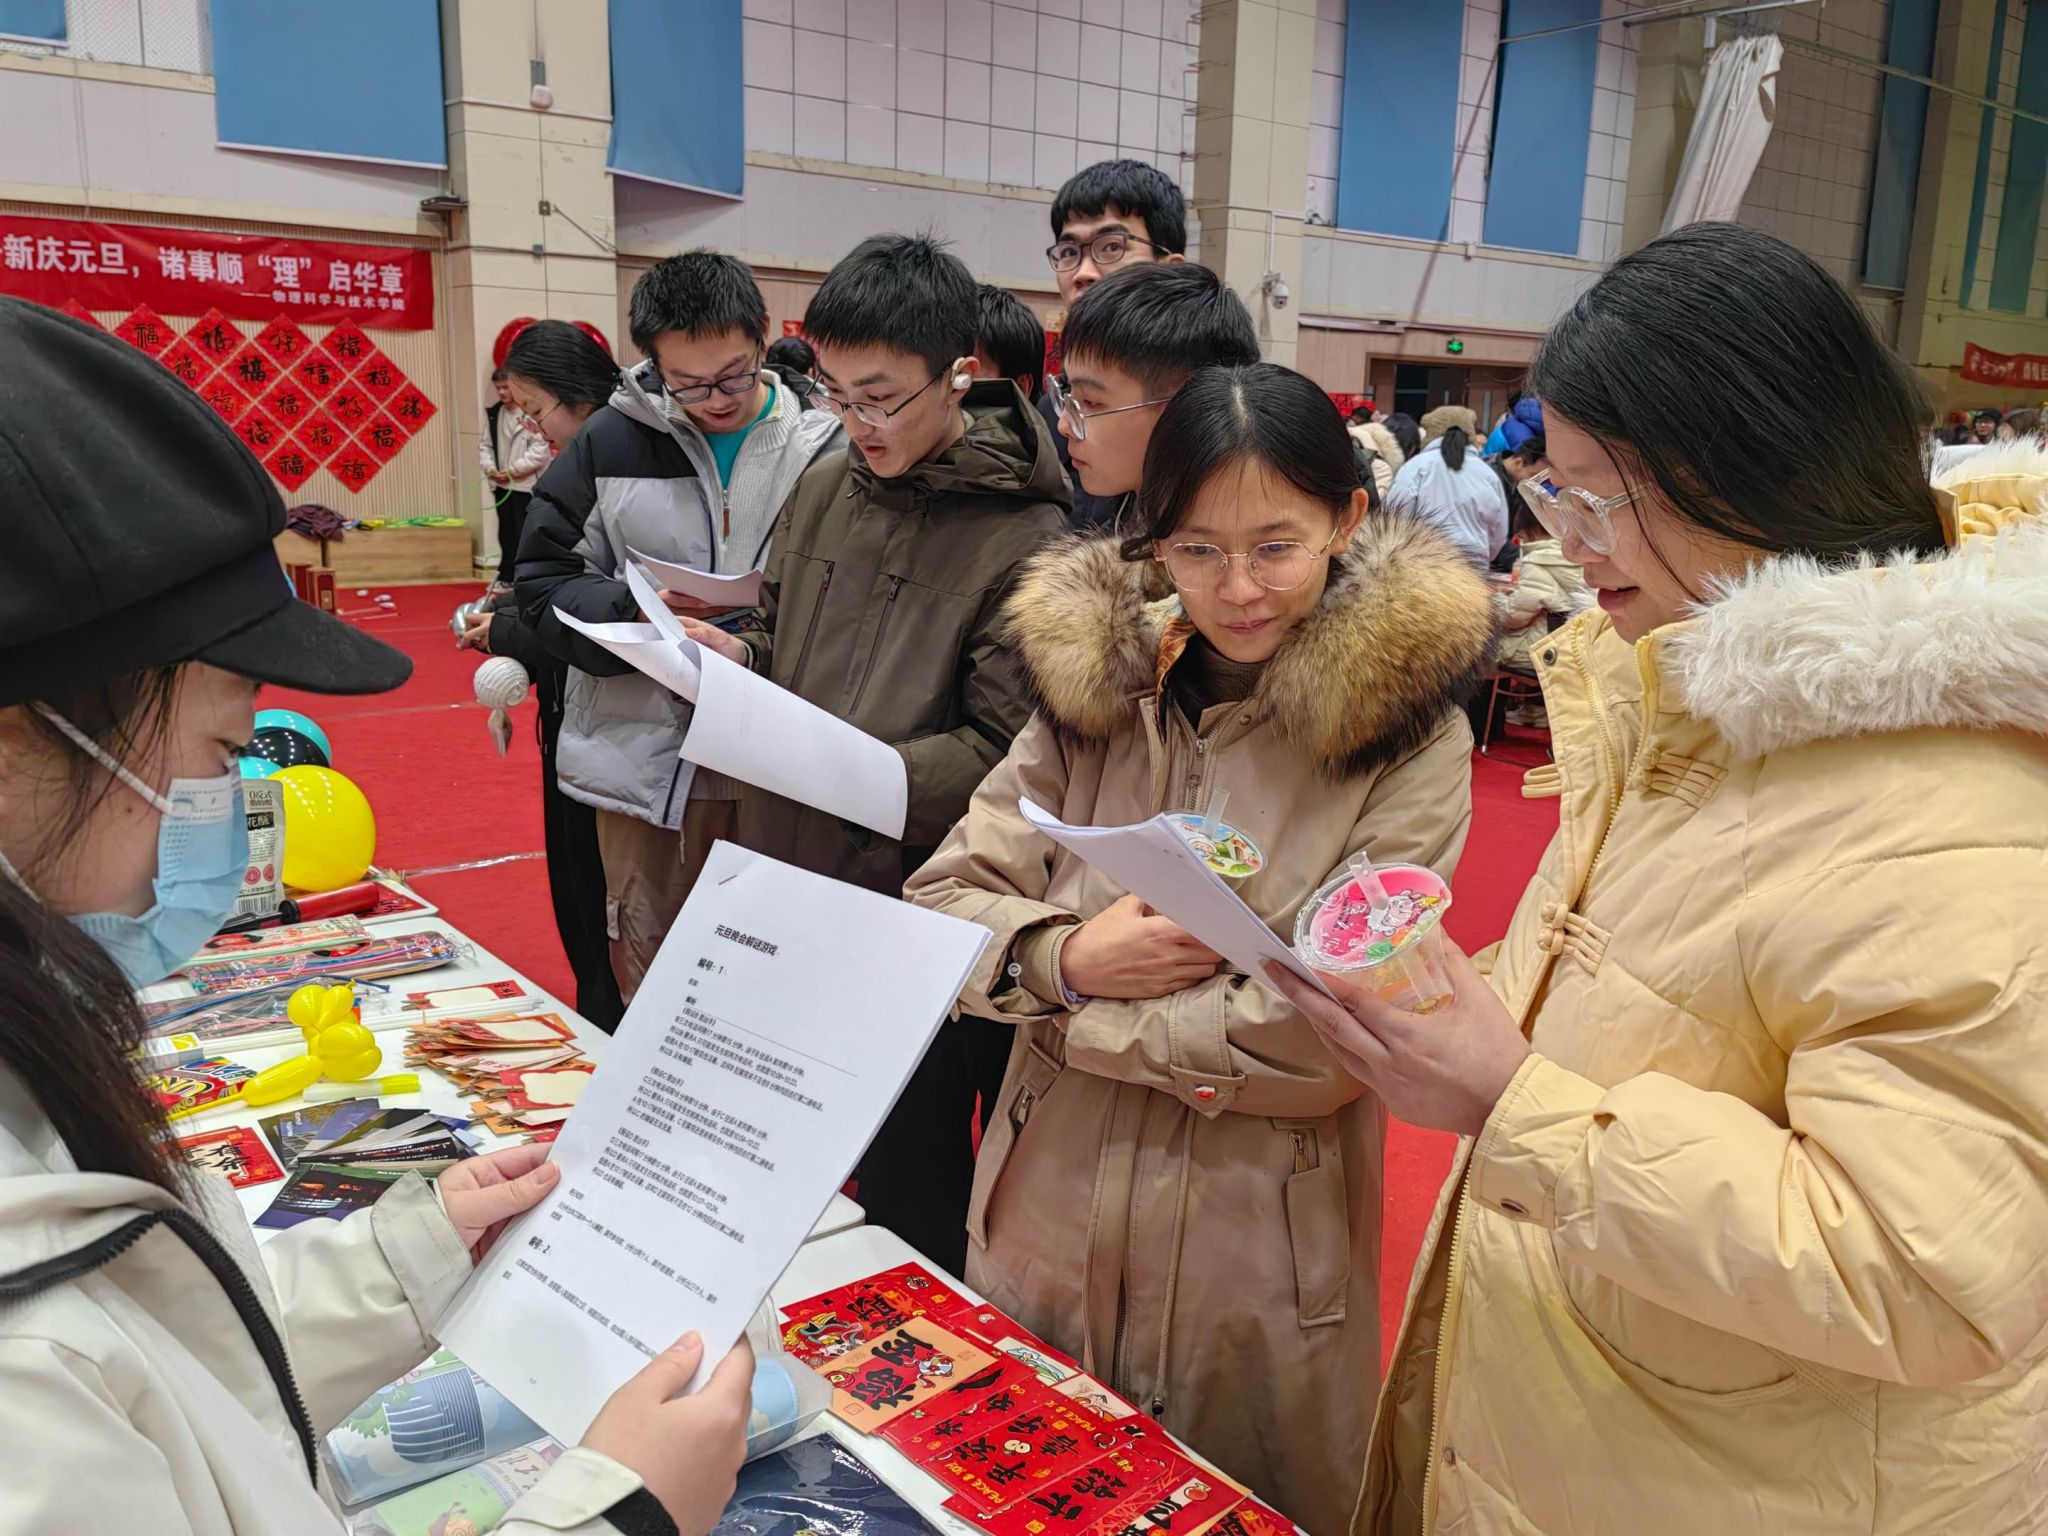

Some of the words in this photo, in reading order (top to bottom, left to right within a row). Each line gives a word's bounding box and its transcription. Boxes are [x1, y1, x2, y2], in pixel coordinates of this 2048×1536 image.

[0, 233, 403, 295] 新庆元旦，诸事顺“理”启华章
[239, 356, 266, 382] 福
[277, 394, 298, 414] 福
[372, 425, 396, 448] 福
[713, 923, 778, 956] 元旦晚会解谜游戏
[1065, 1409, 1095, 1431] PEACE
[975, 1478, 1004, 1503] PEACE
